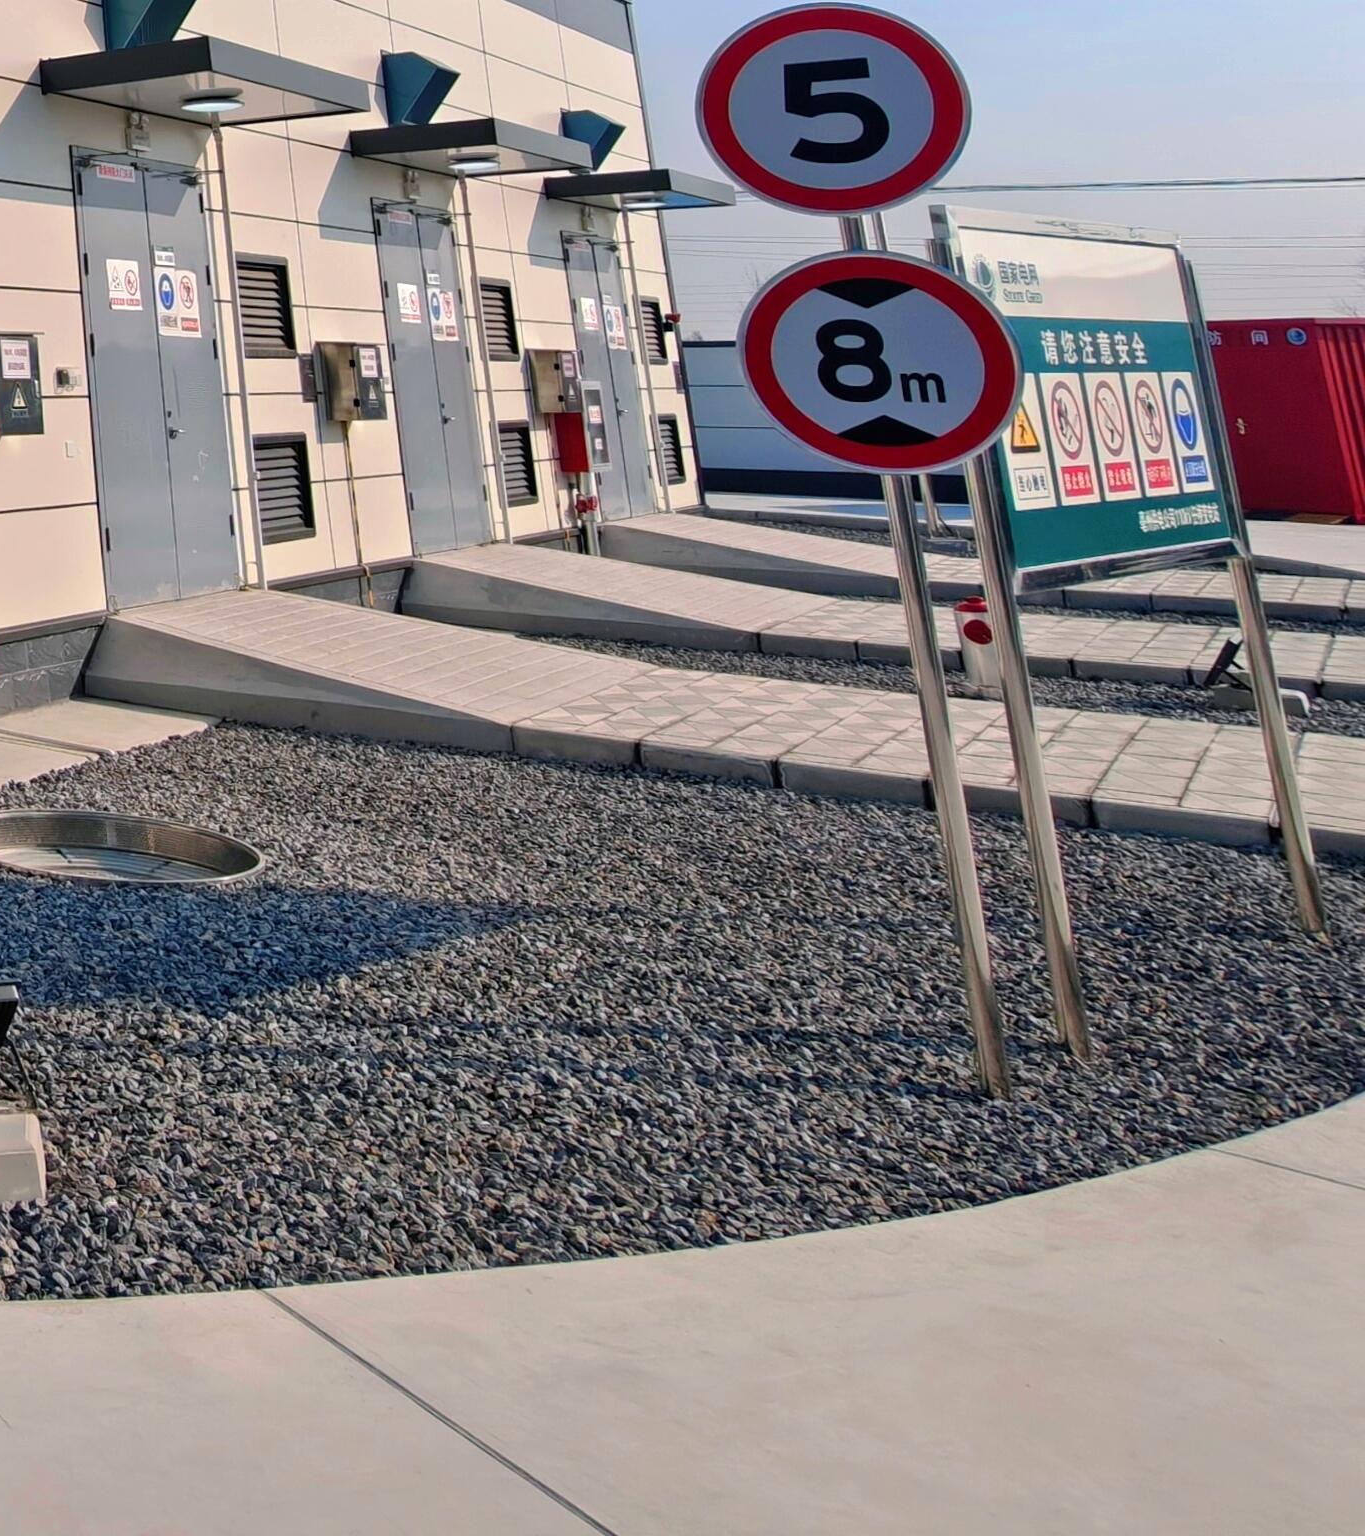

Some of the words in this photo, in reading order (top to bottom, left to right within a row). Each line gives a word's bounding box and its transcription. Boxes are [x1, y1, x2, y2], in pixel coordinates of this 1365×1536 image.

[782, 57, 891, 164] 5
[997, 261, 1040, 286] 国家电网
[1040, 329, 1148, 365] 请您注意安全
